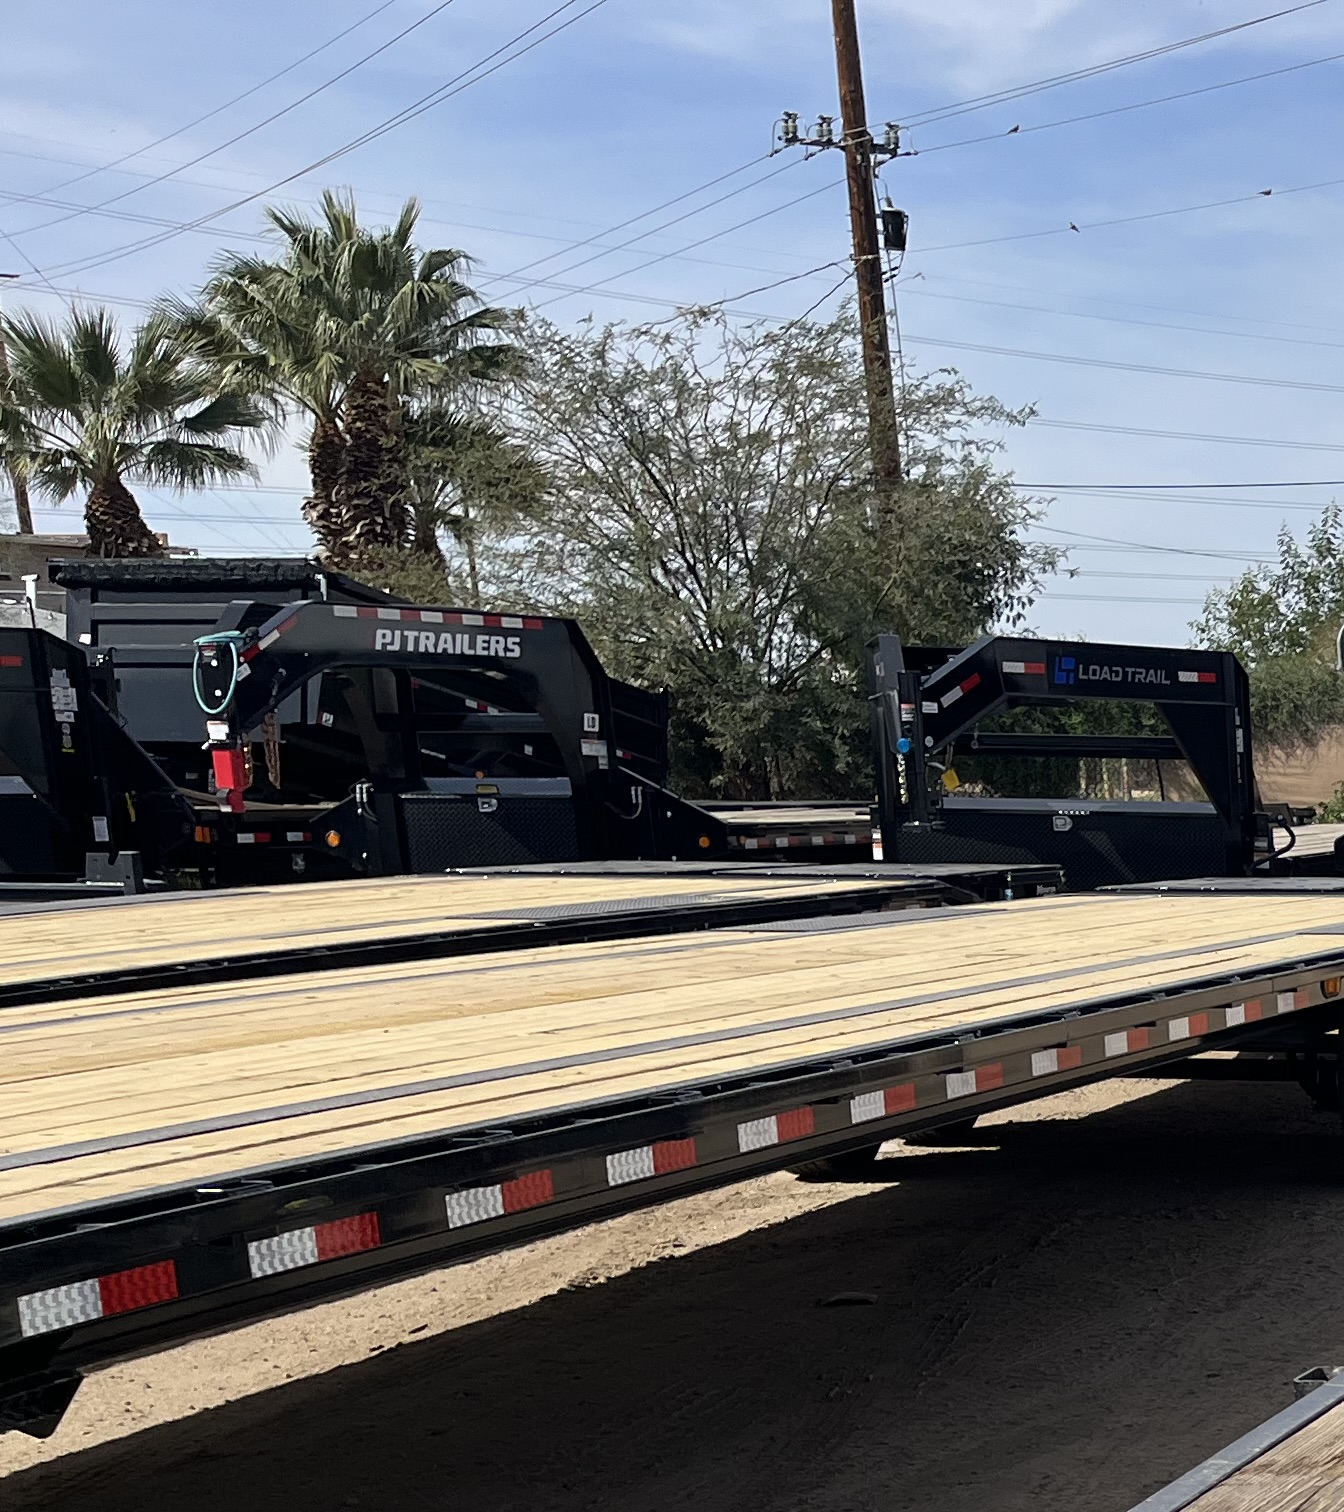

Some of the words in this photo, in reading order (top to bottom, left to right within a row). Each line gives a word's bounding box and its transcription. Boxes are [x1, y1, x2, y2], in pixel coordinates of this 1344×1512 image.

[375, 628, 400, 651] PJ
[403, 630, 521, 658] TRAILERS
[1078, 664, 1123, 681] LOAD
[1124, 667, 1171, 685] TRAIL
